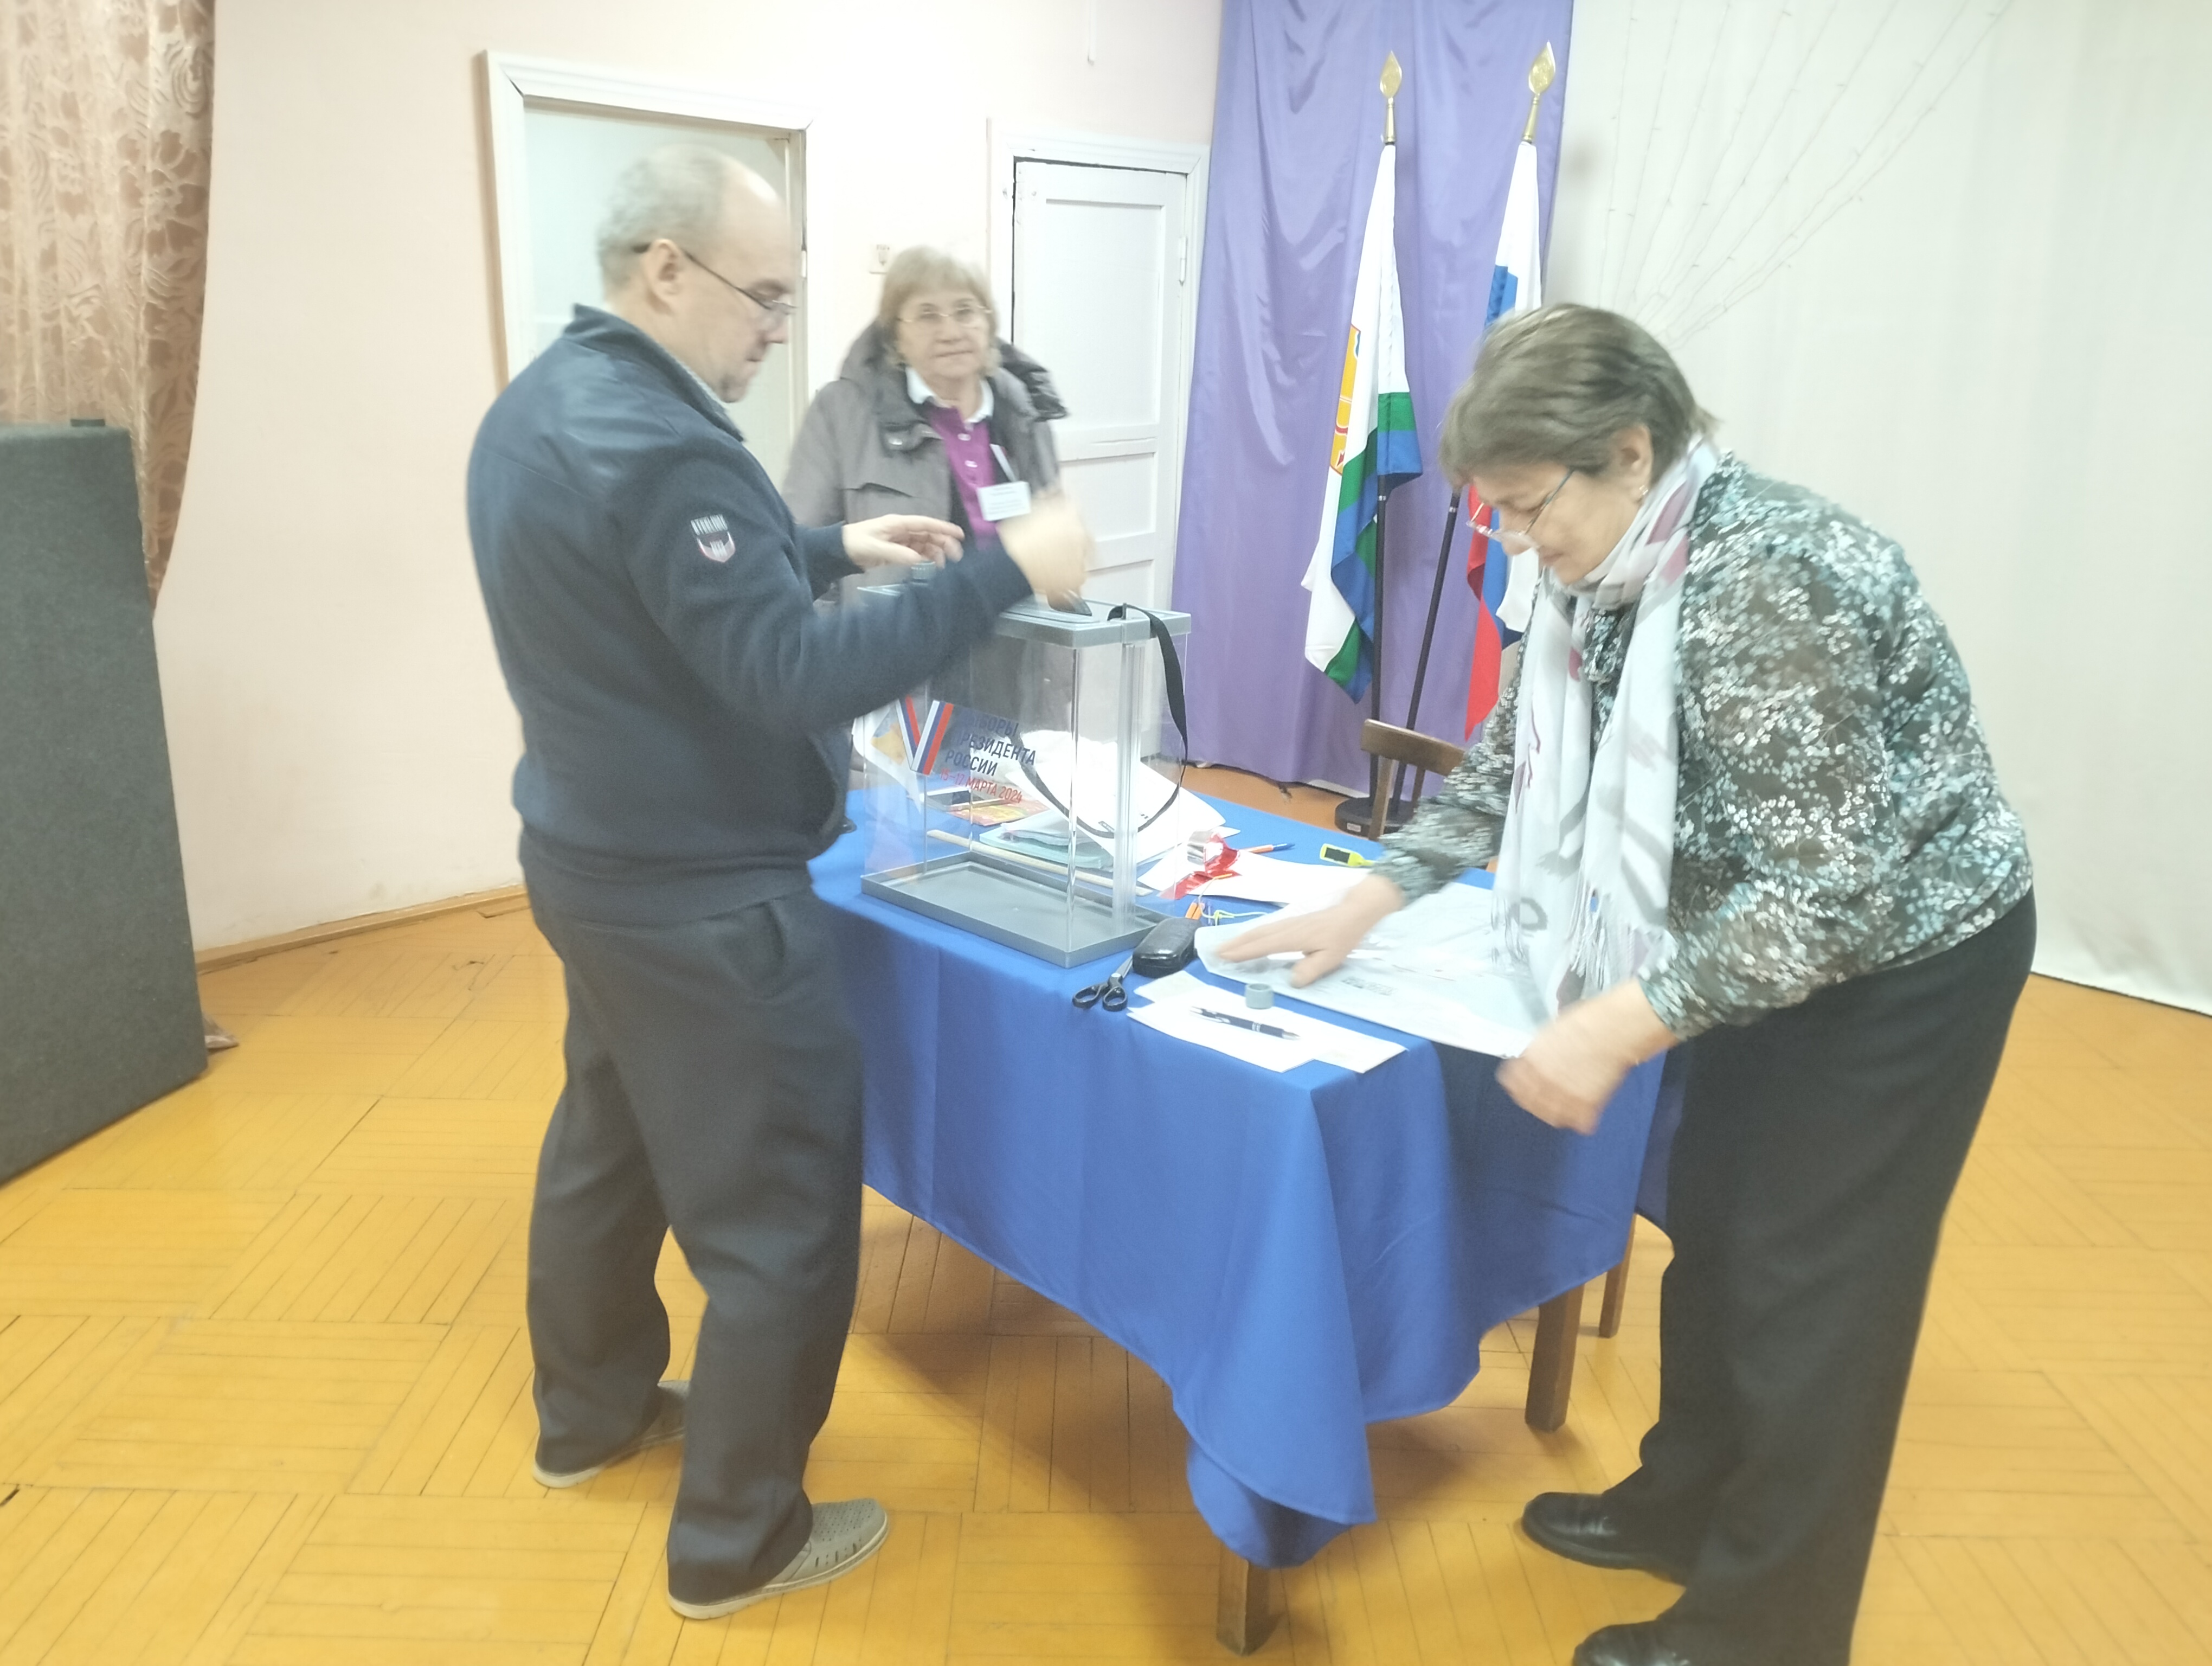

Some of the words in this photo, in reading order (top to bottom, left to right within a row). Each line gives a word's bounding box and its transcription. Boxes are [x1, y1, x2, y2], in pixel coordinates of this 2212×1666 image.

[945, 750, 998, 776] РОССИИ
[966, 776, 997, 796] МАРТА
[999, 786, 1023, 803] 2024
